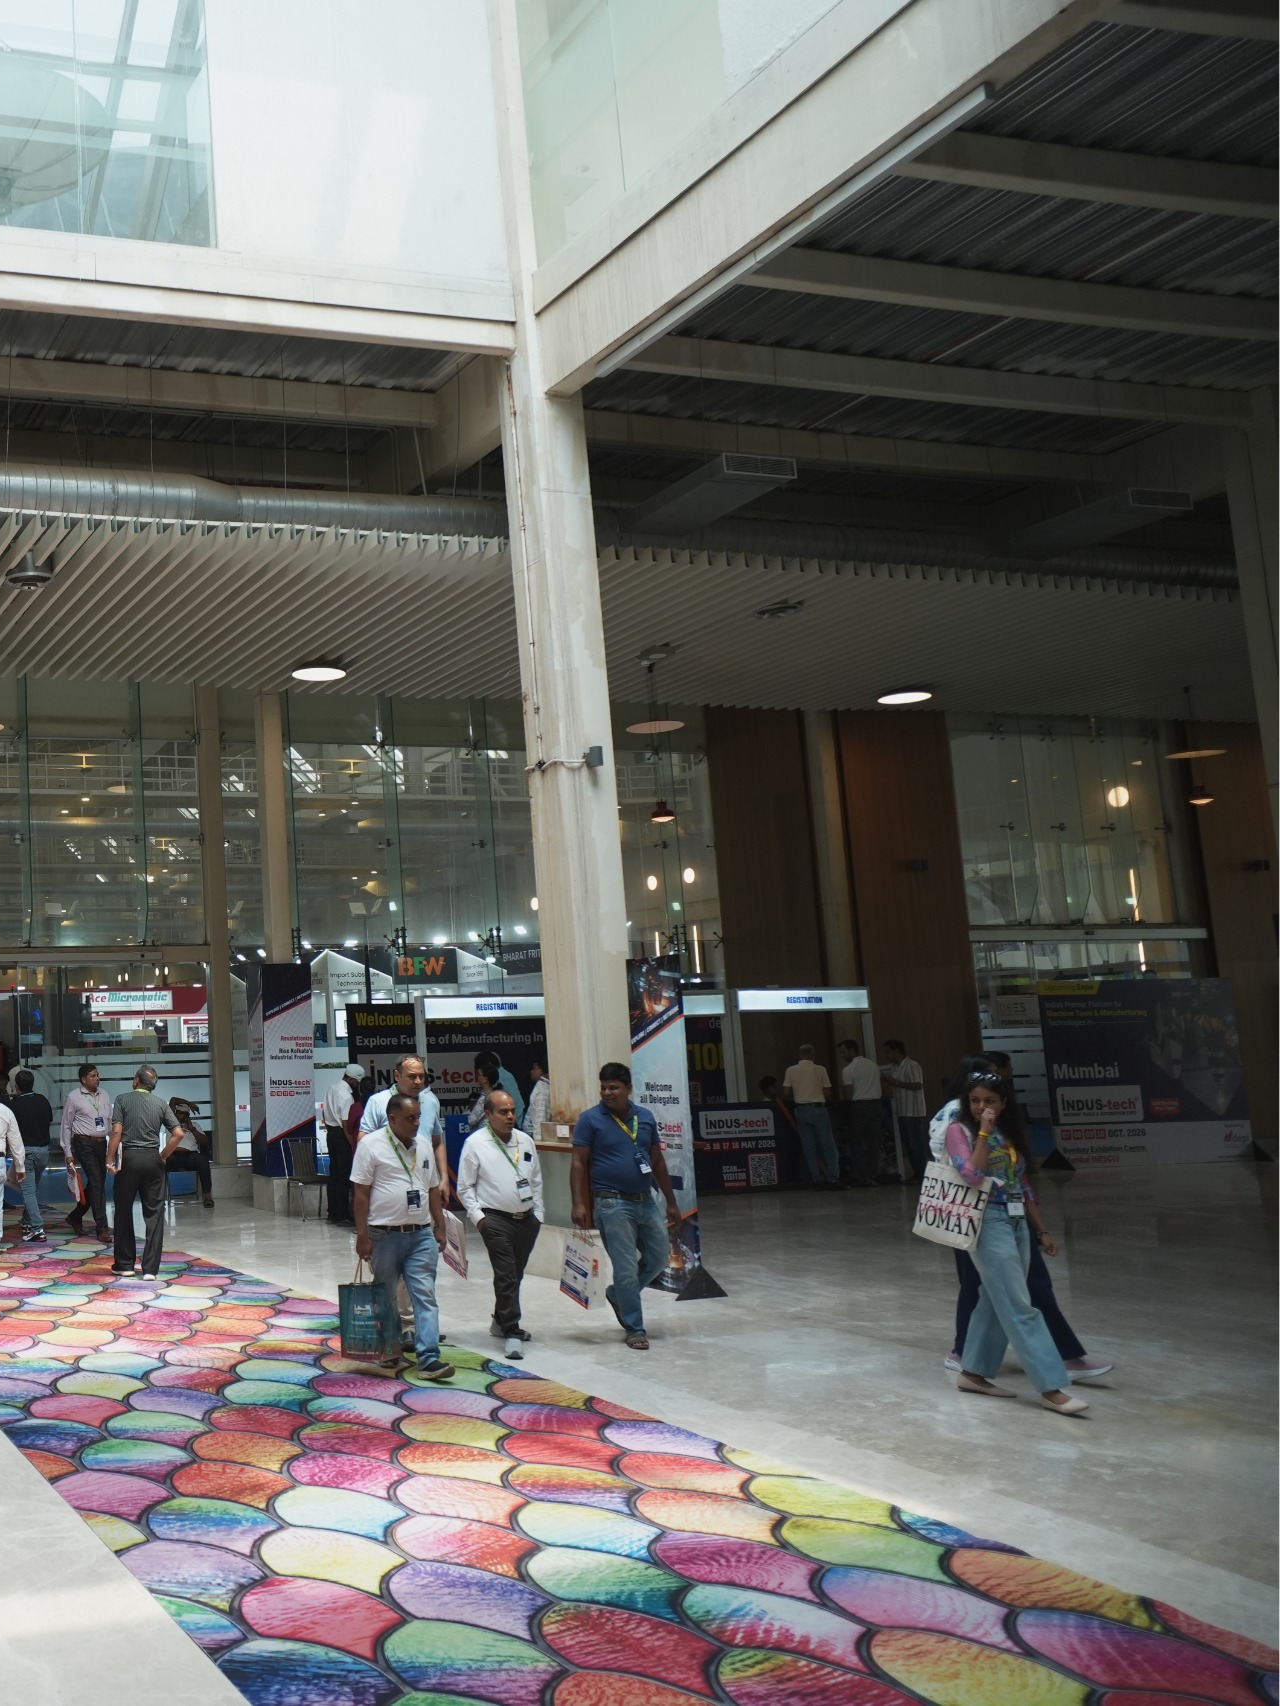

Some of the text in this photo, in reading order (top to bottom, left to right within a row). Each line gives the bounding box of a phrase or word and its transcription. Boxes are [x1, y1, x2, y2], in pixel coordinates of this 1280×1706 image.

[503, 949, 541, 962] BHARAT FRIT
[398, 956, 445, 976] BFW
[350, 971, 380, 979] Subsute
[1044, 983, 1094, 992] Upcoming Expo
[89, 991, 168, 1003] Ace Micromatic
[150, 1002, 169, 1010] Group
[476, 1002, 518, 1011] REGISTRATION
[1099, 1009, 1148, 1018] Manufacturing
[355, 1012, 412, 1026] Welcome
[356, 1032, 544, 1047] Explore Futre of Manufacturing In
[1053, 1062, 1120, 1080] Mumbai
[645, 1082, 672, 1092] Welcome
[640, 1094, 680, 1106] all Delegates
[658, 1122, 682, 1133] S-tech
[1108, 1130, 1125, 1138] OCT.
[1127, 1128, 1146, 1137] 2026
[1231, 1132, 1250, 1144] depl
[741, 1141, 757, 1149] MAY
[758, 1140, 776, 1148] 2026
[1063, 1146, 1089, 1155] Bombay
[1090, 1145, 1123, 1154] Exhibition
[1091, 1155, 1120, 1164] (NESCO)
[722, 1173, 747, 1181] VISITOR
[920, 1176, 989, 1211] GENTLE
